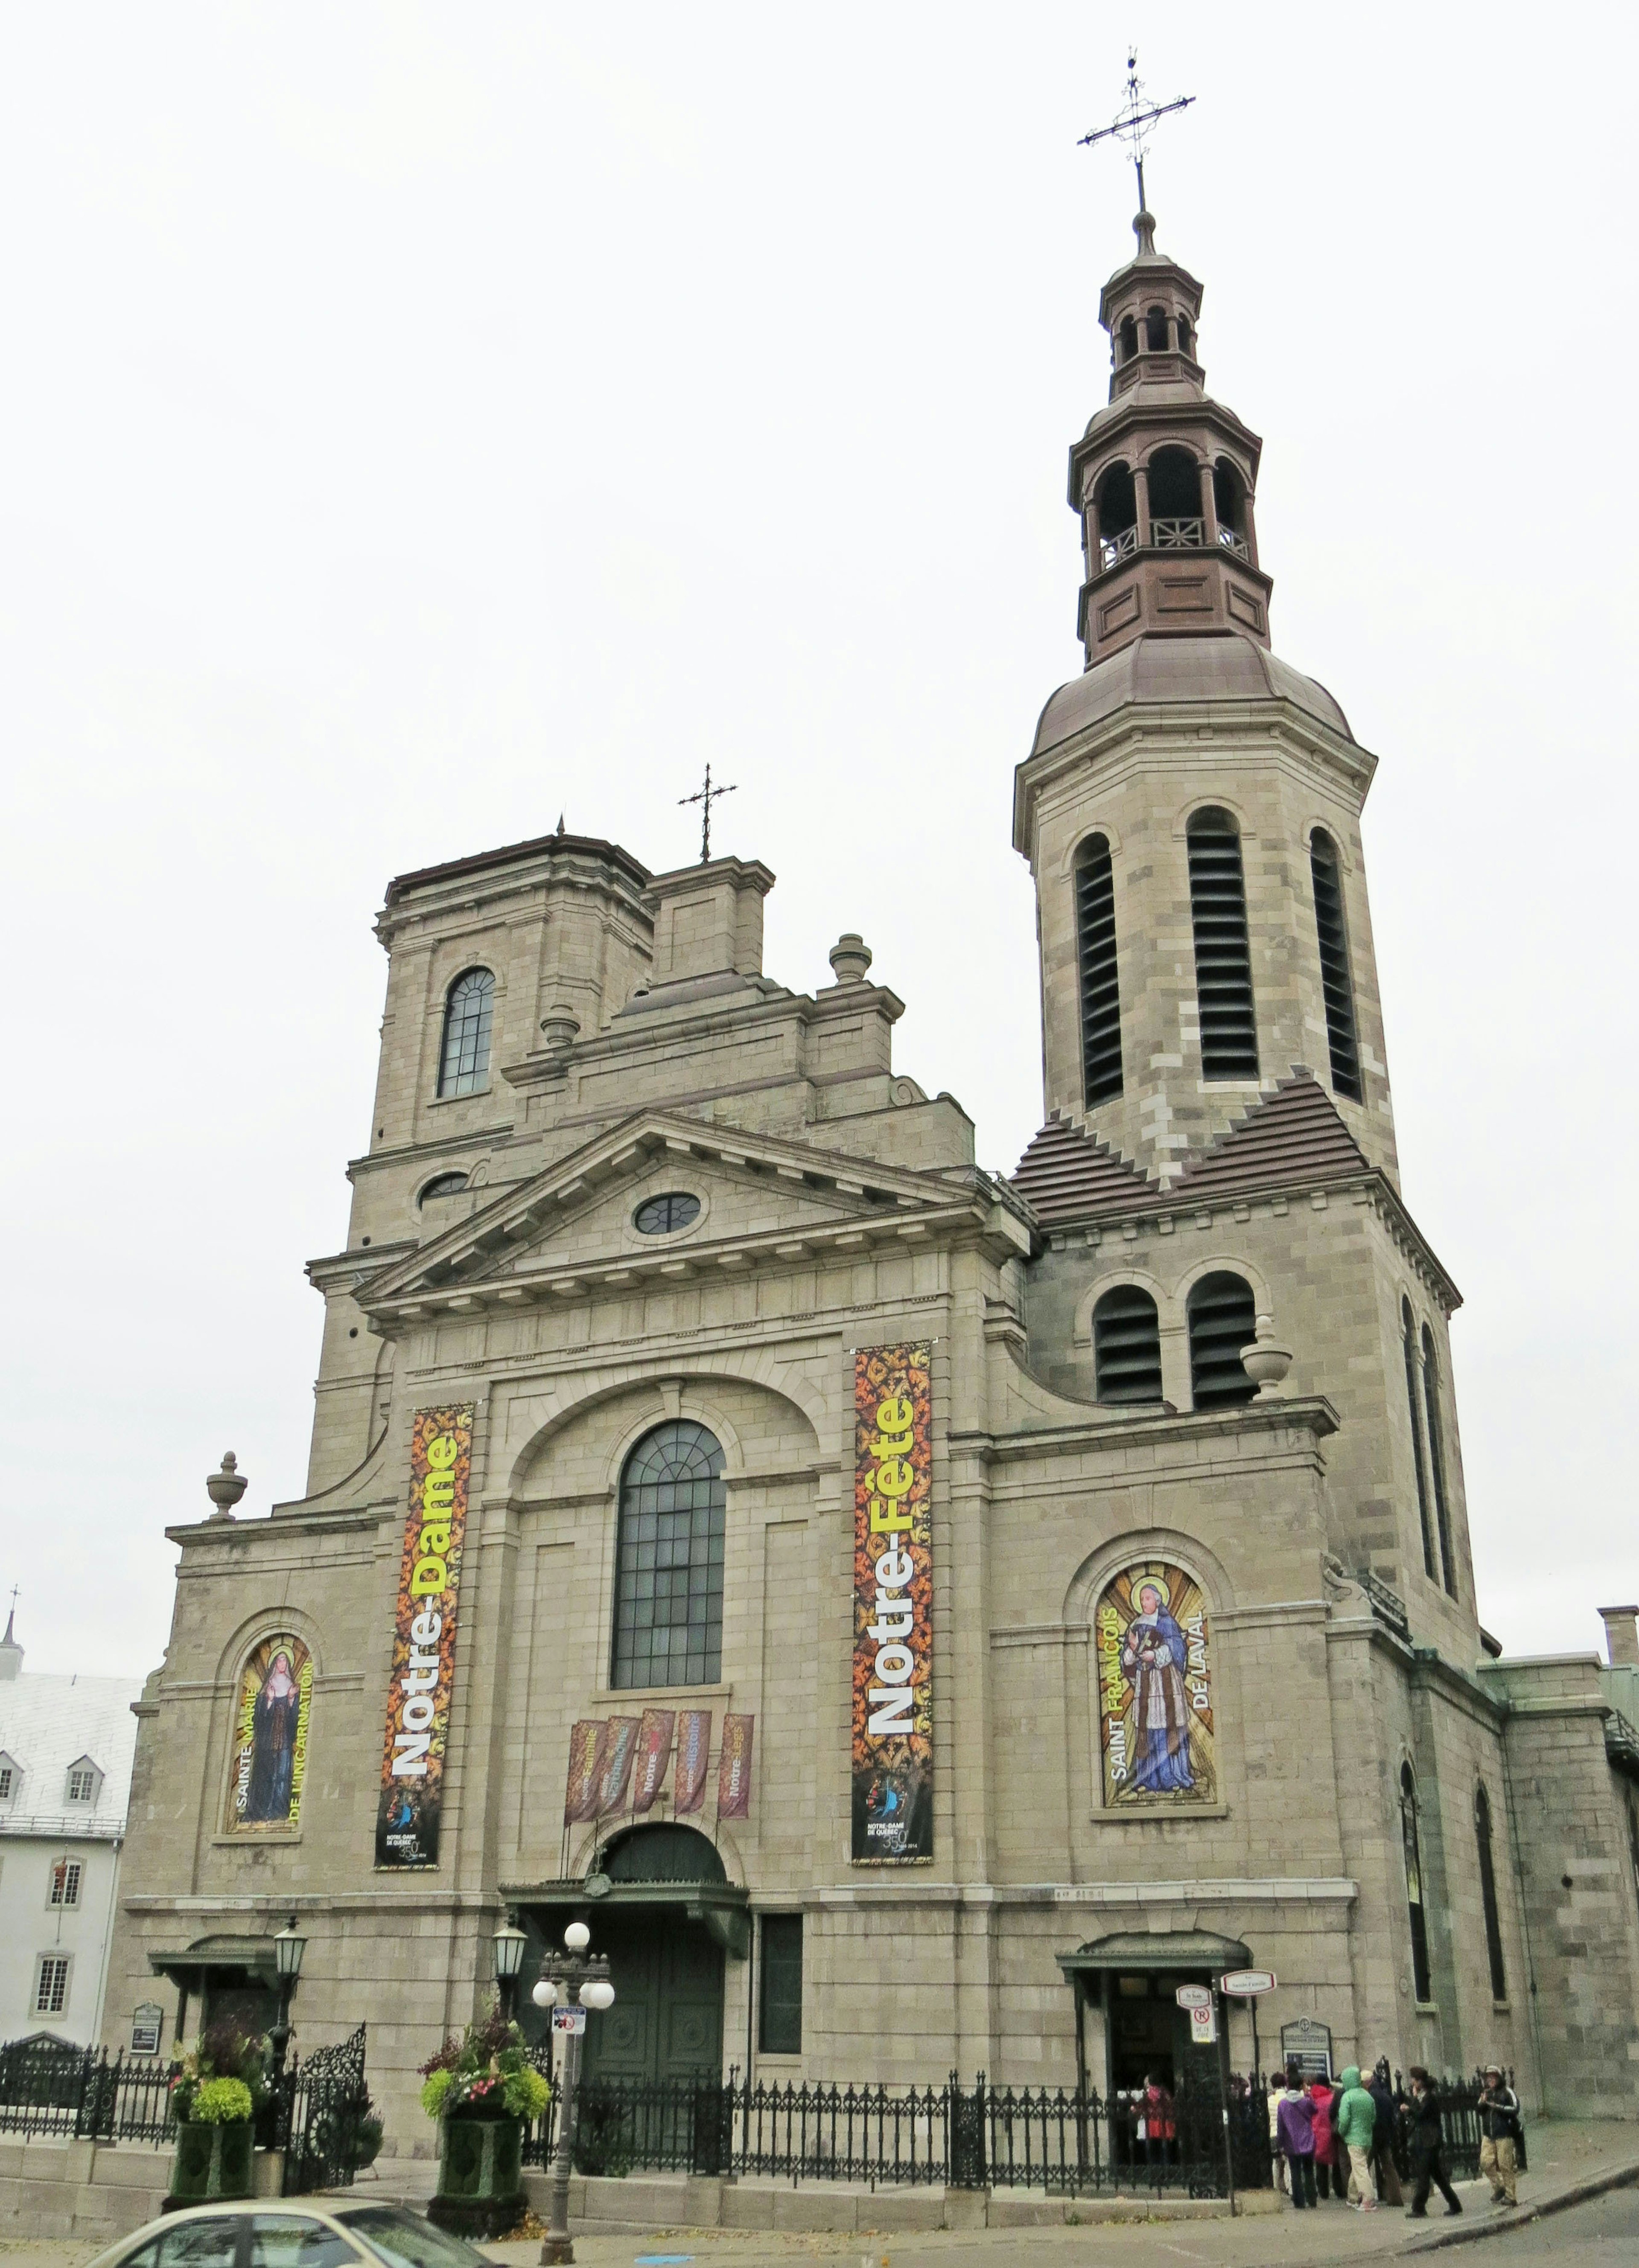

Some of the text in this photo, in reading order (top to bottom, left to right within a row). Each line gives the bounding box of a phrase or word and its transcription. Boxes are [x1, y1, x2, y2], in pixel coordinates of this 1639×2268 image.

[391, 1436, 458, 1776] Notre-Dame
[865, 1397, 914, 1734] Notre-Fête
[289, 1662, 313, 1821] DE L'INCARNATION
[1103, 1607, 1127, 1780] SAINT FRANÇOIS
[1189, 1611, 1209, 1709] DE LAVAL
[236, 1688, 258, 1808] SAINTE MARIE
